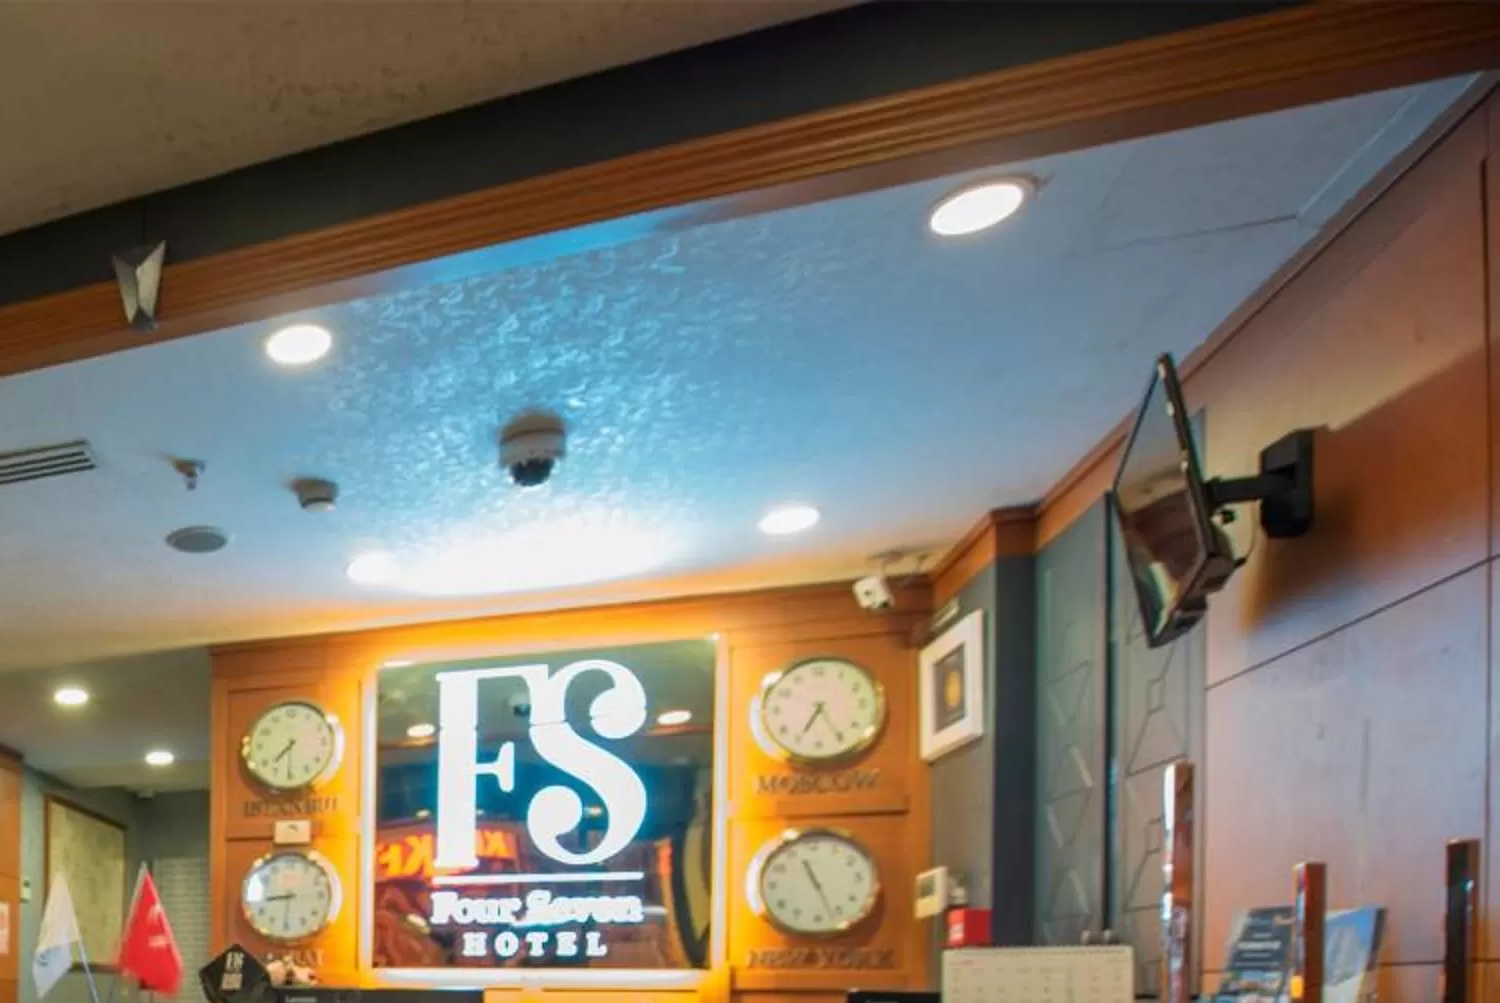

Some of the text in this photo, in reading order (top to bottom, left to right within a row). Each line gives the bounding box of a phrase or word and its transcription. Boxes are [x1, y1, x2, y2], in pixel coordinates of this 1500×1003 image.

[431, 890, 644, 926] Four Seven
[462, 932, 608, 956] HOTEL
